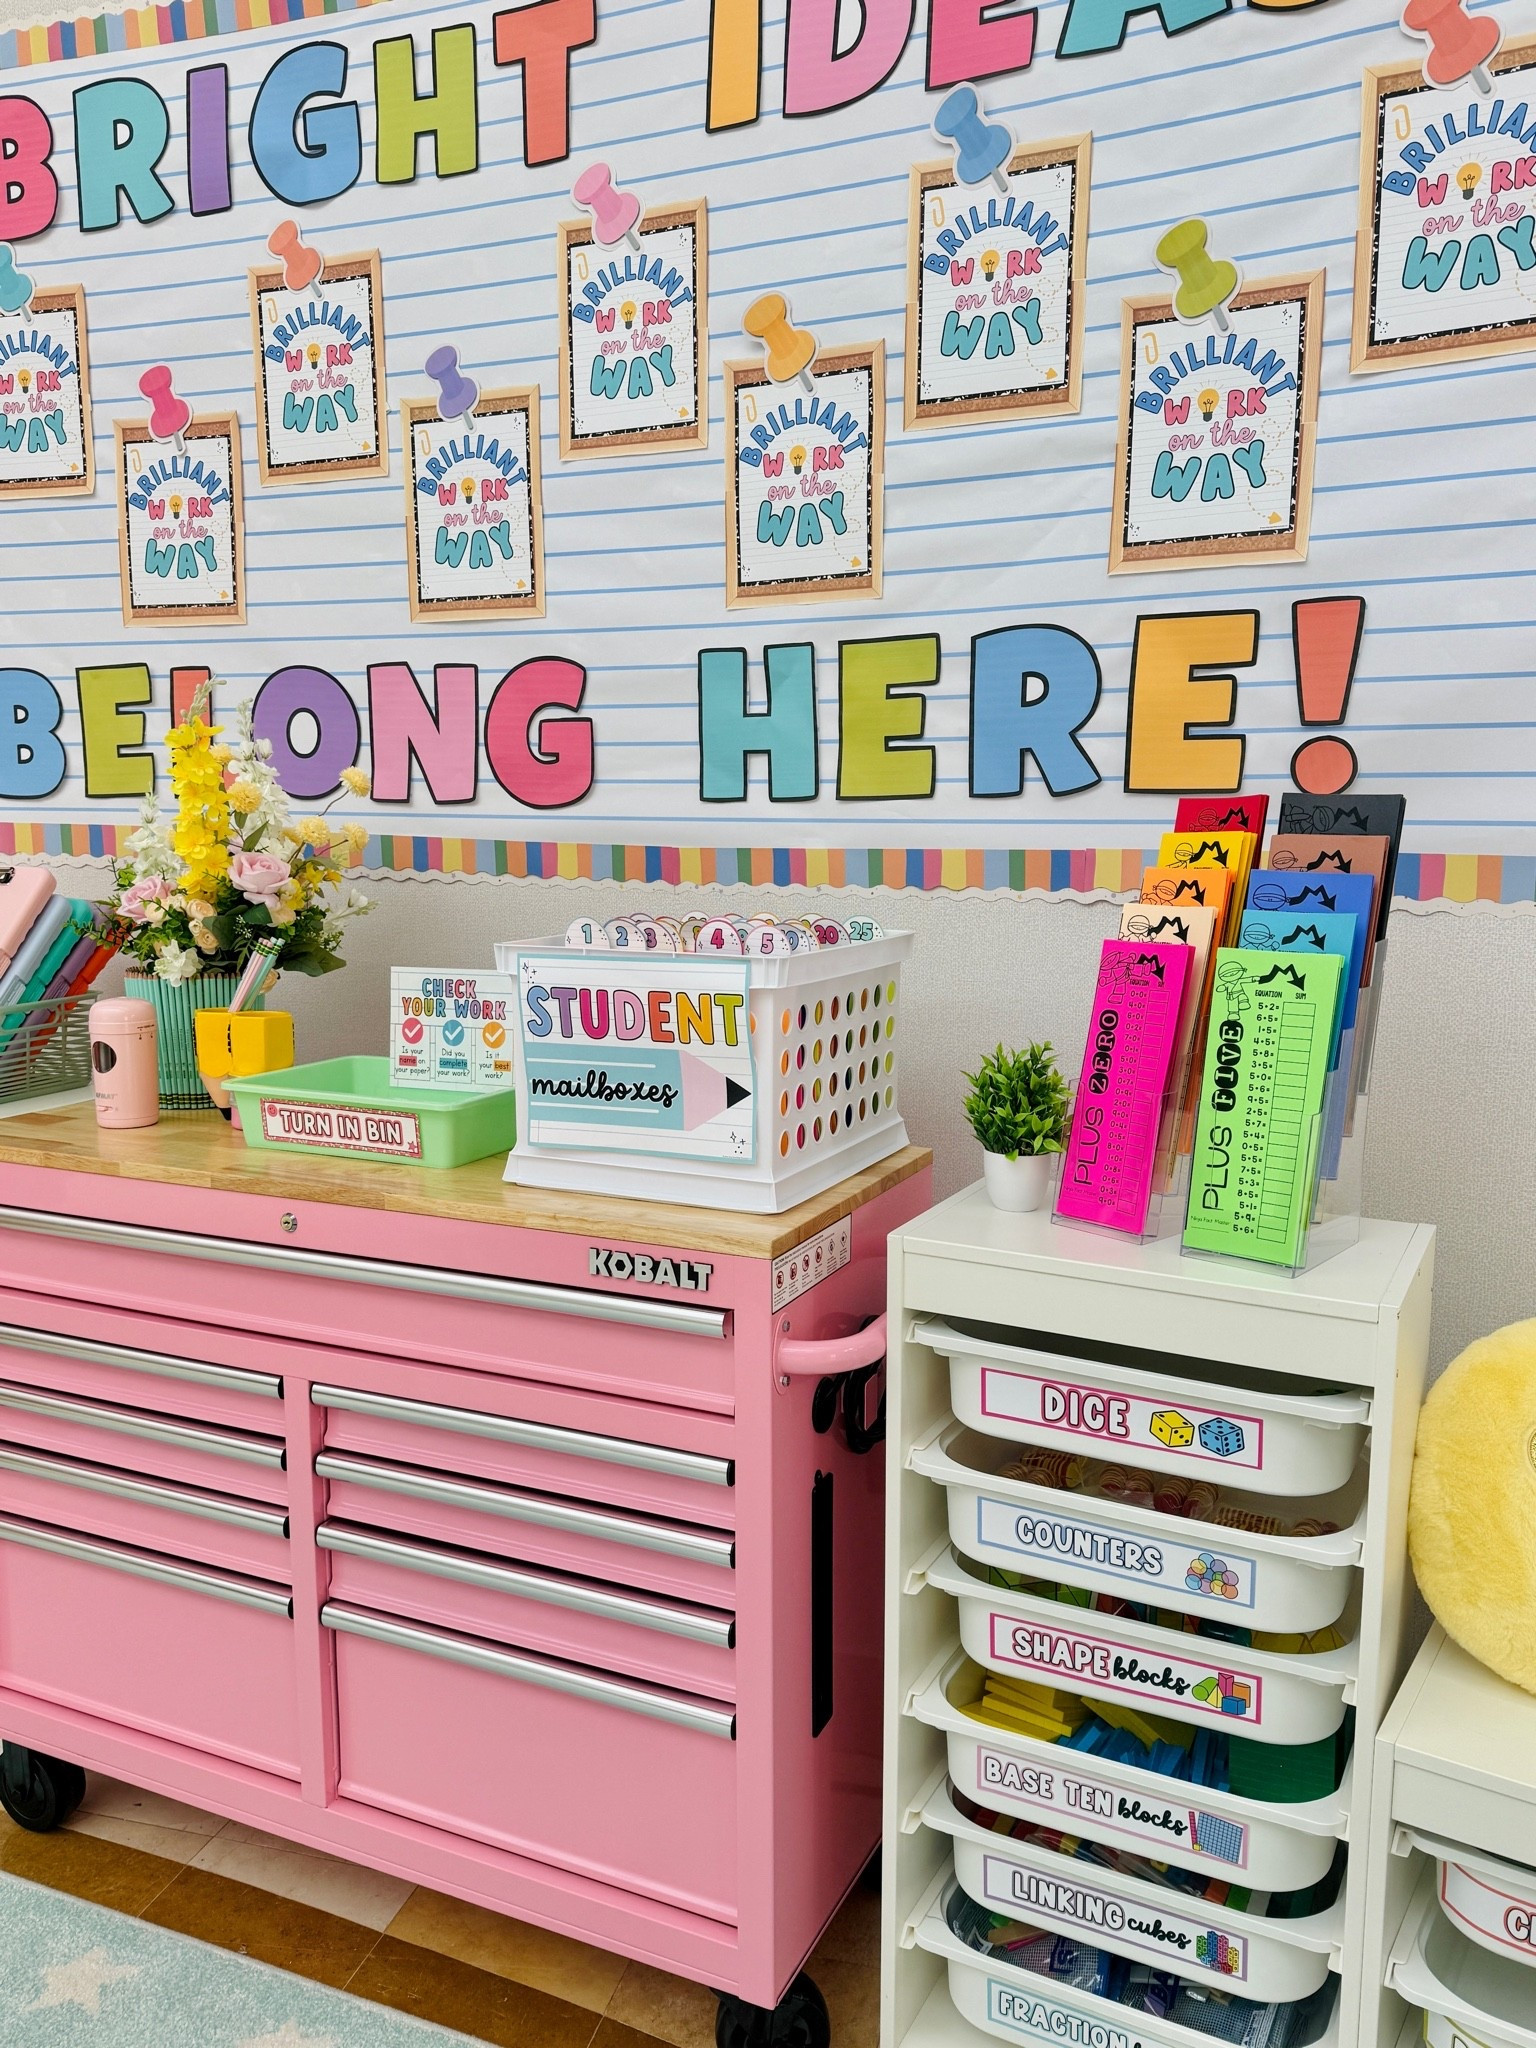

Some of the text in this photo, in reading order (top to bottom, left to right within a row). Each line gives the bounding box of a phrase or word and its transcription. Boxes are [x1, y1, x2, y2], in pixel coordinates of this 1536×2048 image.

[0, 0, 597, 241] BRIGHT
[1422, 195, 1525, 236] on the
[923, 197, 1069, 276] BRILLIANT
[1402, 215, 1536, 293] WAY
[572, 254, 693, 324] BRILLIANT
[955, 281, 1034, 311] on the
[265, 301, 370, 363] BRILLIANT
[601, 328, 666, 356] on the
[940, 297, 1044, 360] WAY
[291, 370, 348, 393] on the
[590, 345, 676, 400] WAY
[1134, 333, 1297, 415] BRILLIANT
[3, 392, 57, 414] on the
[282, 384, 358, 433] WAY
[0, 408, 67, 453] WAY
[739, 397, 866, 468] BRILLIANT
[1168, 418, 1257, 453] on the
[129, 456, 230, 511] BRILLIANT
[417, 434, 528, 496] BRILLIANT
[1151, 438, 1267, 503] WAY
[767, 473, 837, 501] on the
[153, 518, 208, 540] on the
[444, 504, 503, 527] on the
[756, 491, 848, 547] WAY
[145, 536, 218, 579] WAY
[435, 520, 514, 569] WAY
[697, 596, 1365, 802] HERE!
[581, 923, 592, 944] 1
[615, 926, 629, 946] 2
[644, 928, 657, 948] 3
[710, 928, 724, 949] 4
[760, 933, 774, 954] 5
[814, 925, 839, 944] 20
[849, 921, 874, 941] 25
[402, 997, 506, 1020] YOUR WORK
[422, 978, 477, 999] CHECK
[1255, 990, 1283, 998] EQUATION
[526, 985, 744, 1046] STUDENT
[410, 1048, 424, 1056] your
[410, 1067, 431, 1076] paper?
[439, 1059, 468, 1068] complete
[442, 1048, 466, 1058] Did you
[494, 1061, 510, 1070] best
[452, 1069, 470, 1077] work?
[485, 1072, 504, 1080] work?
[531, 1070, 678, 1109] mailboxes
[1074, 1009, 1118, 1186] PLUS ZERO
[1202, 1020, 1244, 1212] PLUS FIVE
[279, 1108, 403, 1145] TURN IN BIN
[588, 1247, 714, 1291] KOBALT
[1041, 1384, 1129, 1437] DICE
[1016, 1516, 1163, 1575] COUNTERS
[1012, 1627, 1191, 1696] SHAPE blocks
[985, 1756, 1189, 1836] BASE TEN blocks
[1012, 1870, 1192, 1949] LINKING cubes
